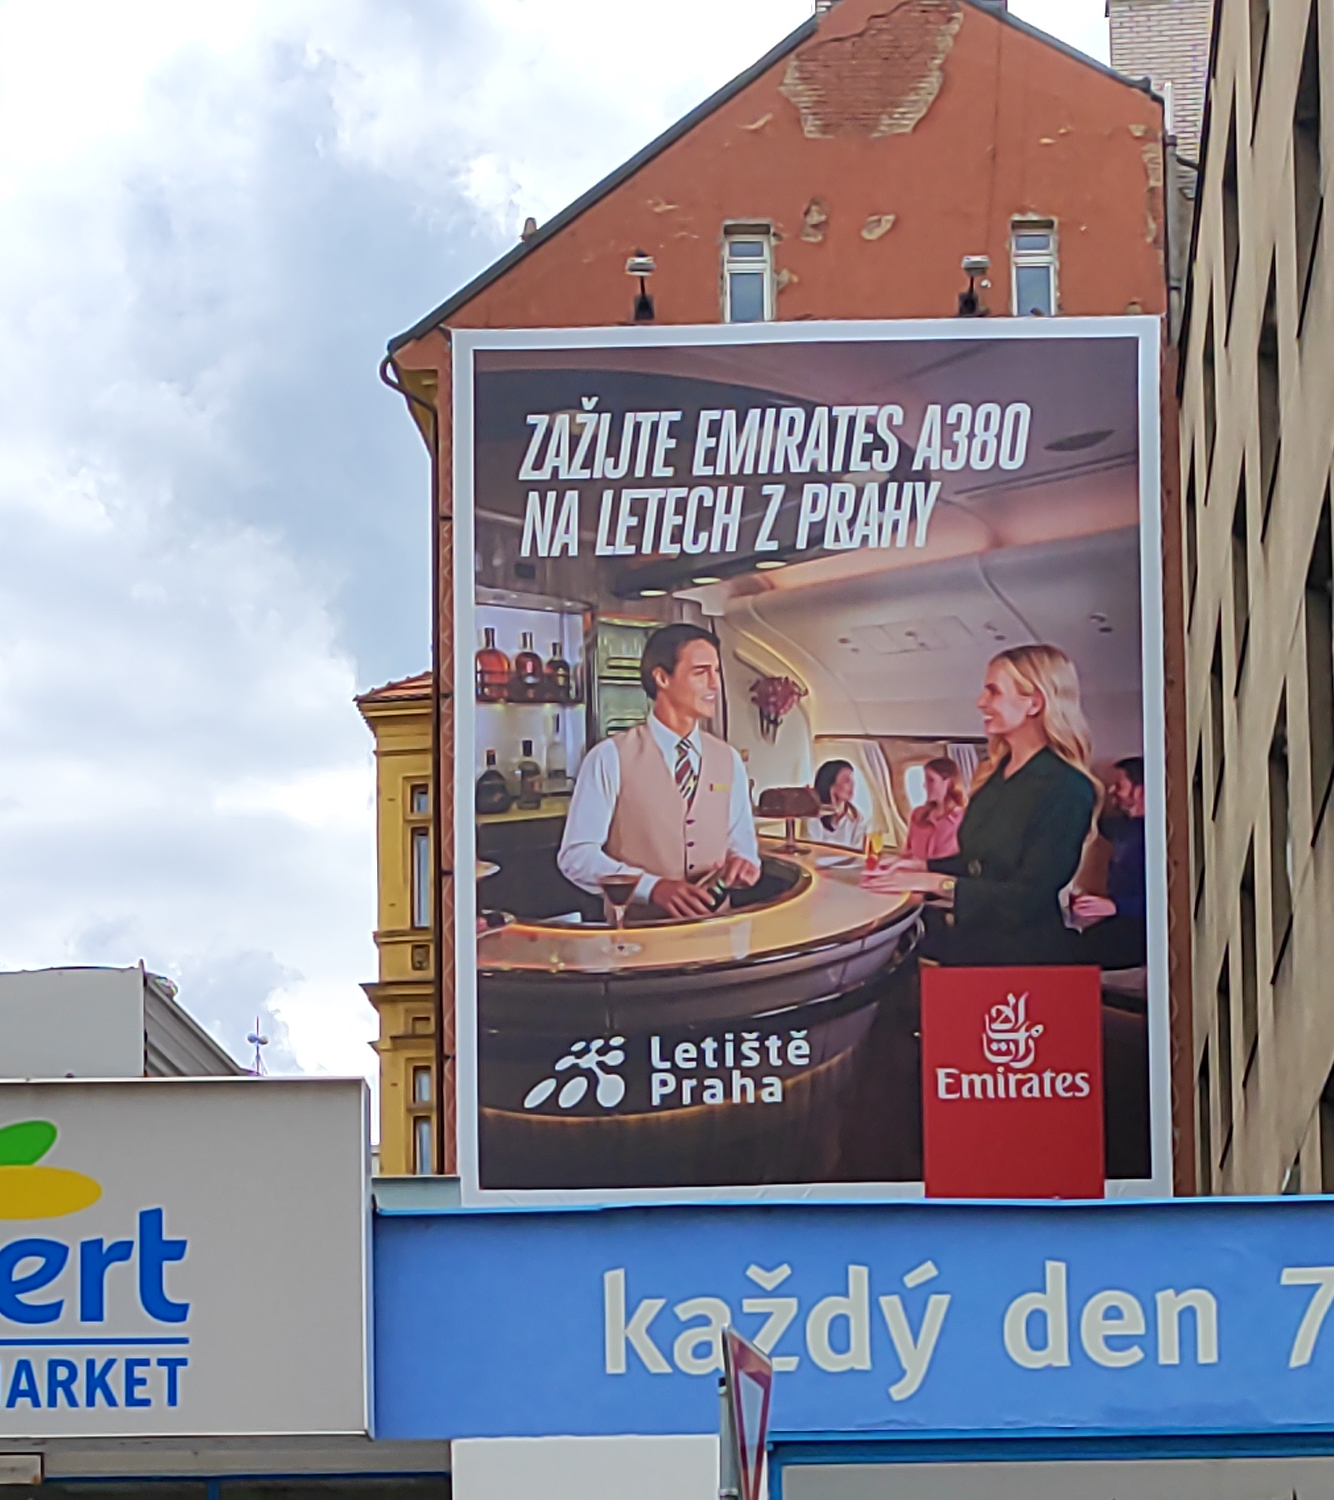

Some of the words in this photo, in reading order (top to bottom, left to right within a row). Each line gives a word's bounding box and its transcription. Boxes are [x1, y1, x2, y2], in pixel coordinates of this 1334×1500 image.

[518, 396, 681, 480] ZAŽIJTE
[691, 402, 904, 477] EMIRATES
[913, 402, 1031, 472] A380
[520, 489, 580, 557] NA
[595, 485, 745, 556] LETECH
[754, 483, 786, 551] Z
[795, 480, 942, 550] PRAHY
[650, 1029, 812, 1070] Letiště
[651, 1070, 784, 1106] Praha
[935, 1066, 1091, 1100] Emirates
[603, 1259, 952, 1401] každý
[1003, 1260, 1220, 1370] den
